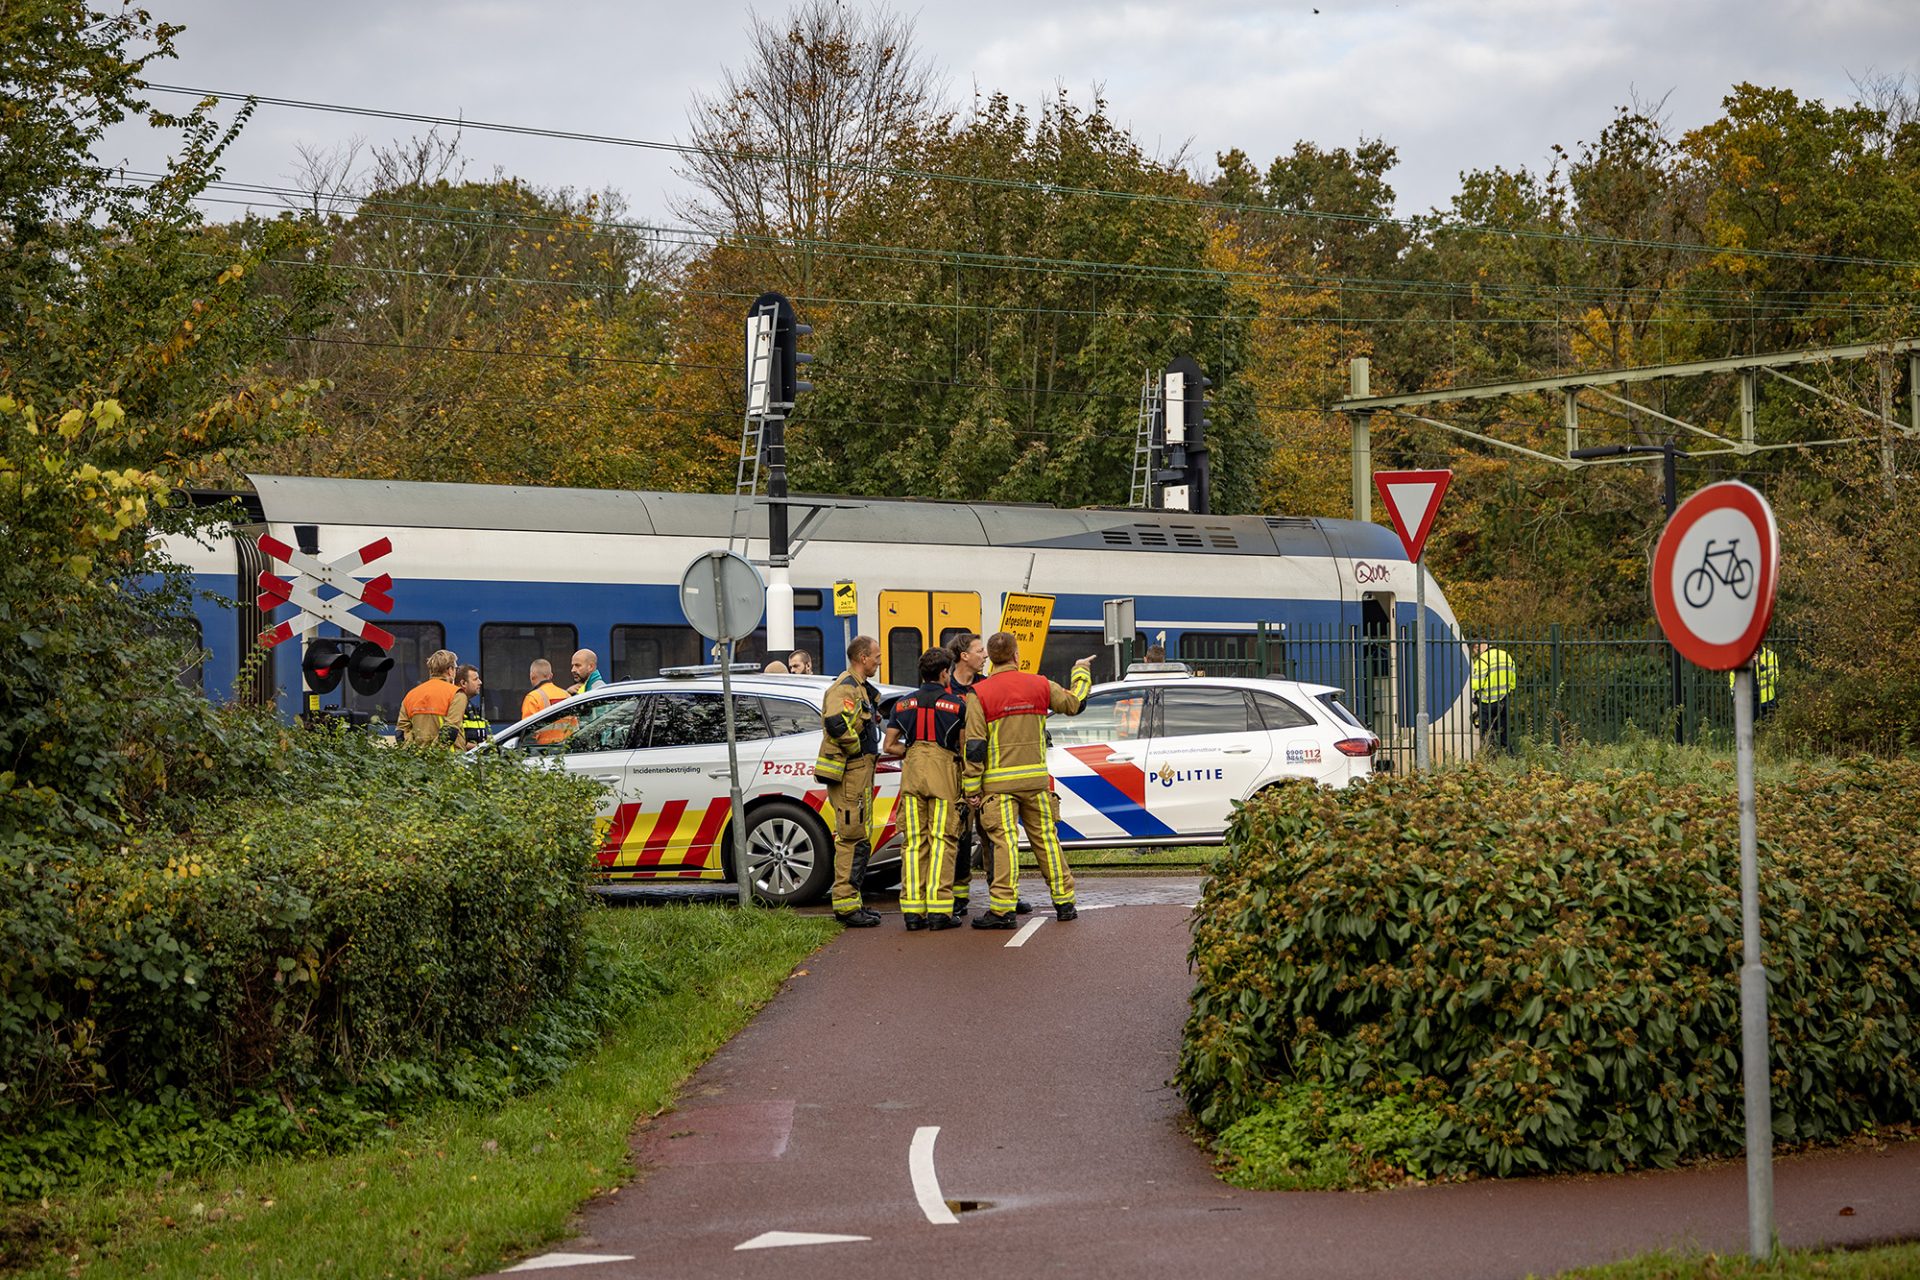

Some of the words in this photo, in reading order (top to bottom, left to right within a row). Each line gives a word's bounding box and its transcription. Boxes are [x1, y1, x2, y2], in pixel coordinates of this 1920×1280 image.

[1008, 603, 1046, 617] spoorovergang
[1005, 616, 1032, 629] afgesloten
[1033, 620, 1043, 628] van
[1156, 630, 1166, 648] 1
[1304, 749, 1320, 758] 112
[633, 766, 701, 775] Incidentenbestrijding
[762, 760, 815, 776] ProRa
[1150, 769, 1222, 787] POLITIE
